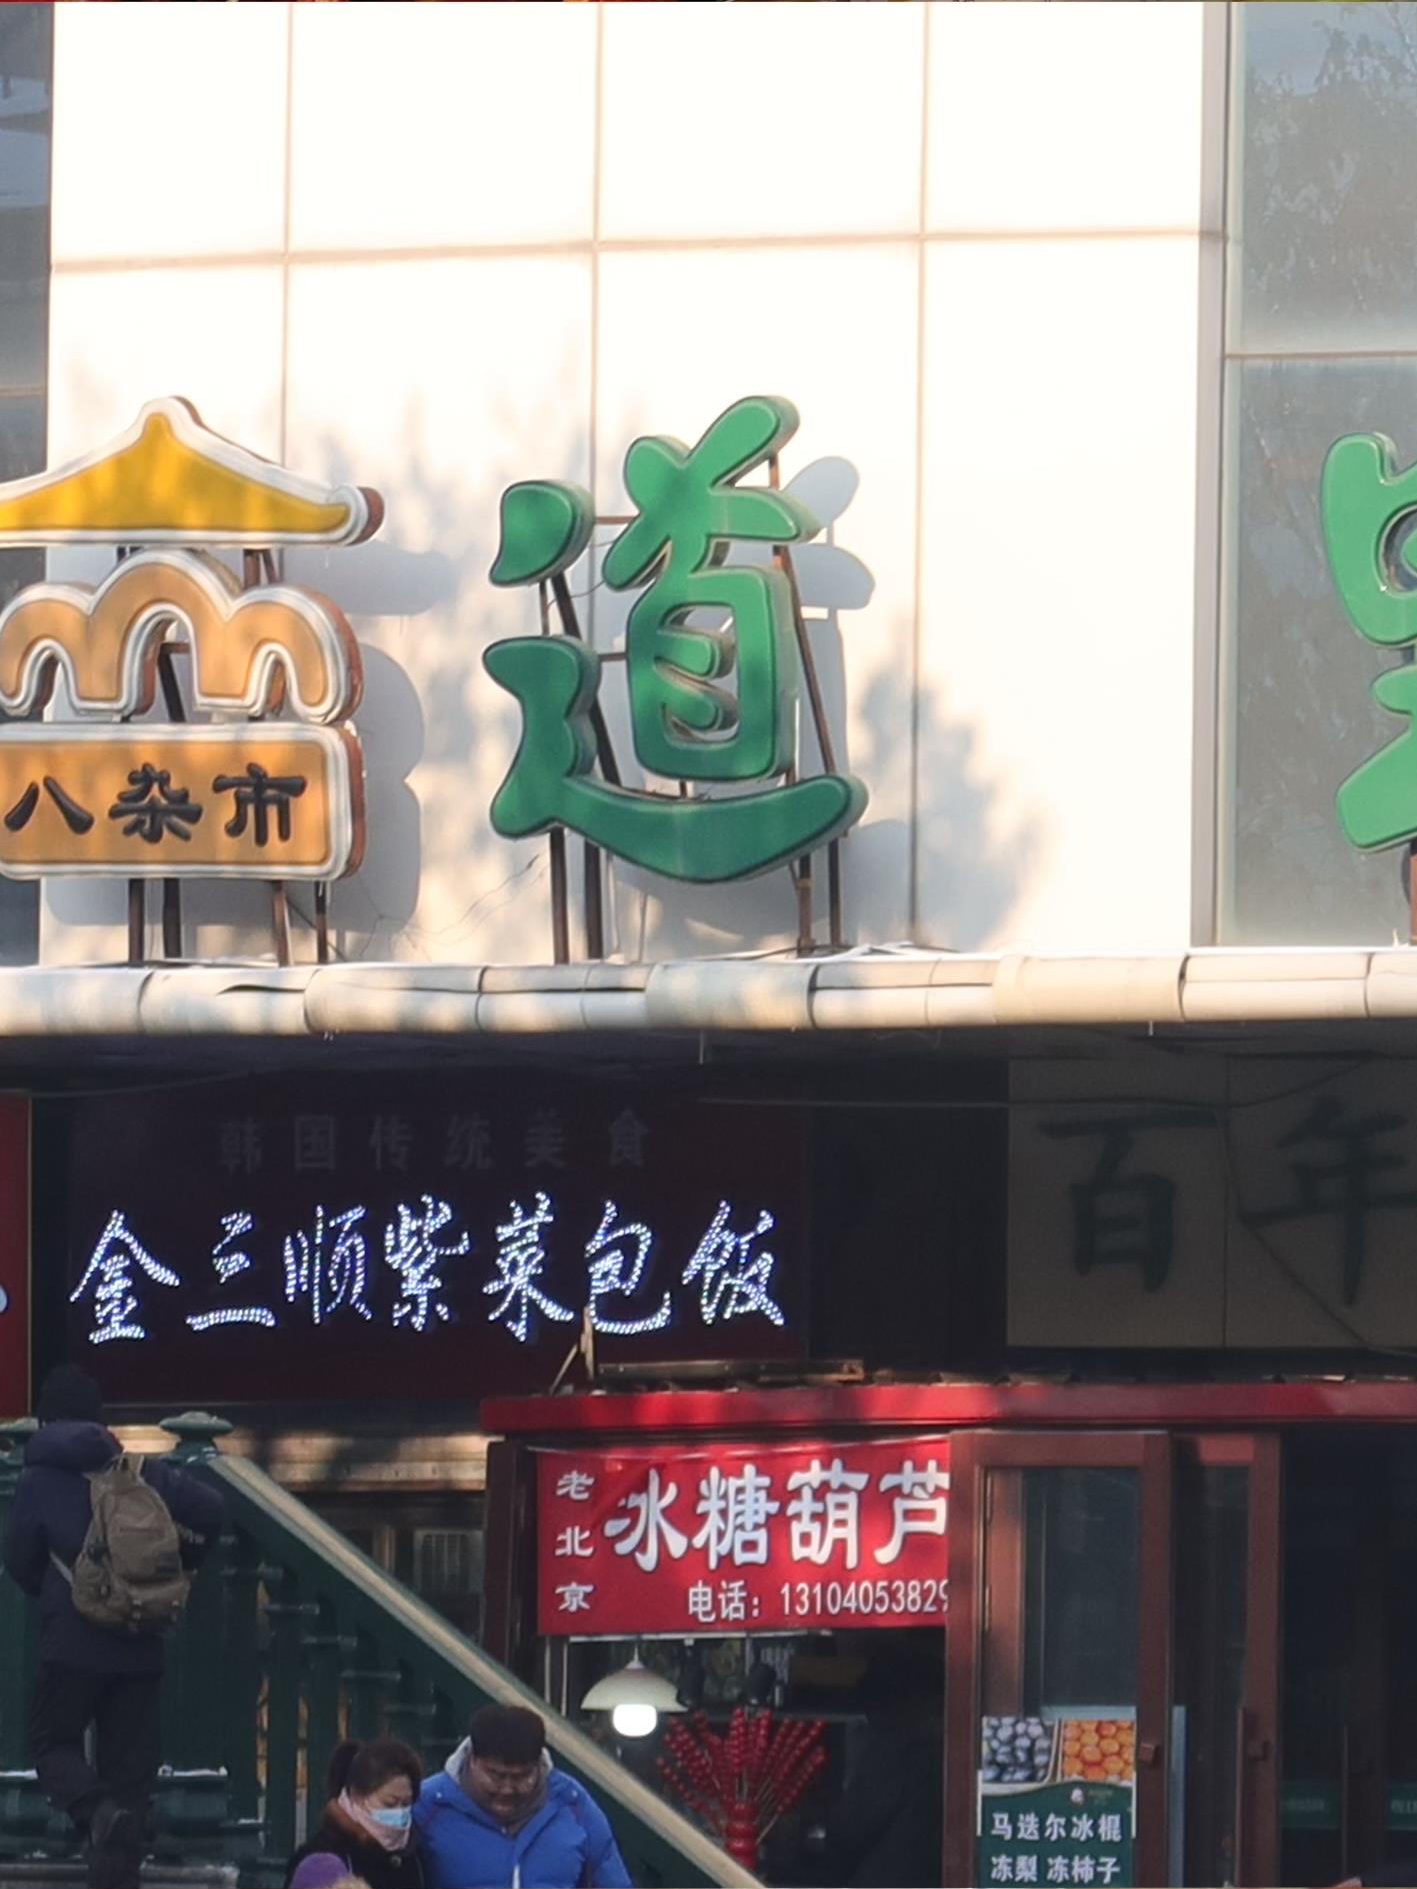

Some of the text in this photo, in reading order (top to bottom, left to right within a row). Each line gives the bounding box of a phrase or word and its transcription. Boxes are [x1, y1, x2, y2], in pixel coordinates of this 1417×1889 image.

[3, 761, 309, 847] 八杂市
[218, 1108, 652, 1177] 韩国传统美食
[69, 1191, 785, 1344] 金三顺紫菜包饭
[554, 1469, 596, 1613] 老北京
[604, 1458, 950, 1573] 冰糖葫芦
[990, 1811, 1124, 1844] 马迭尔冰棍
[990, 1854, 1121, 1885] 冻梨 冻柿子
